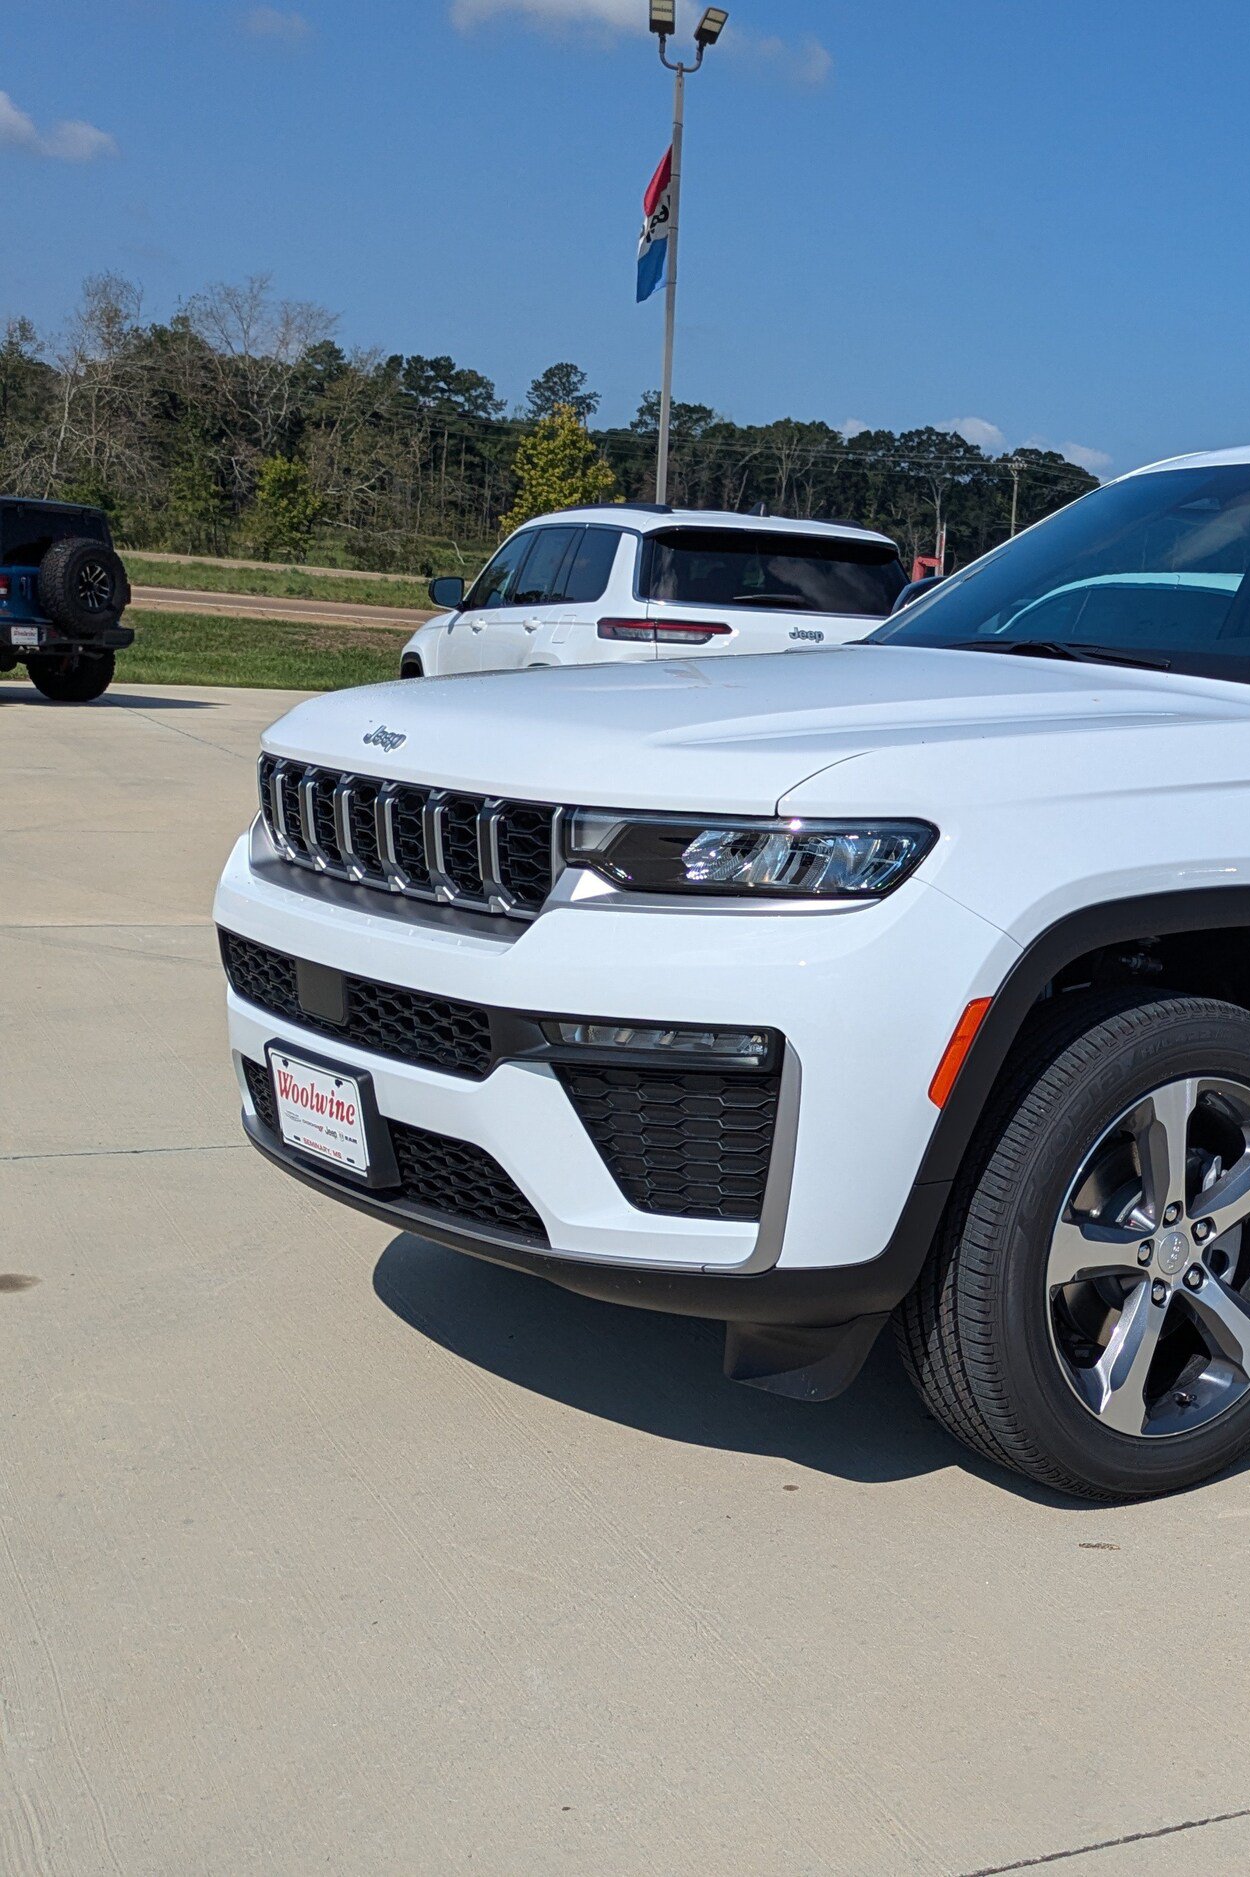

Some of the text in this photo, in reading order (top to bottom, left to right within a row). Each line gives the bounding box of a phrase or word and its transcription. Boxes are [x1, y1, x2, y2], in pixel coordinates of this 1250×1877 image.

[789, 627, 824, 643] Jeep
[363, 725, 407, 752] Jeep
[277, 1069, 355, 1125] Woolwine
